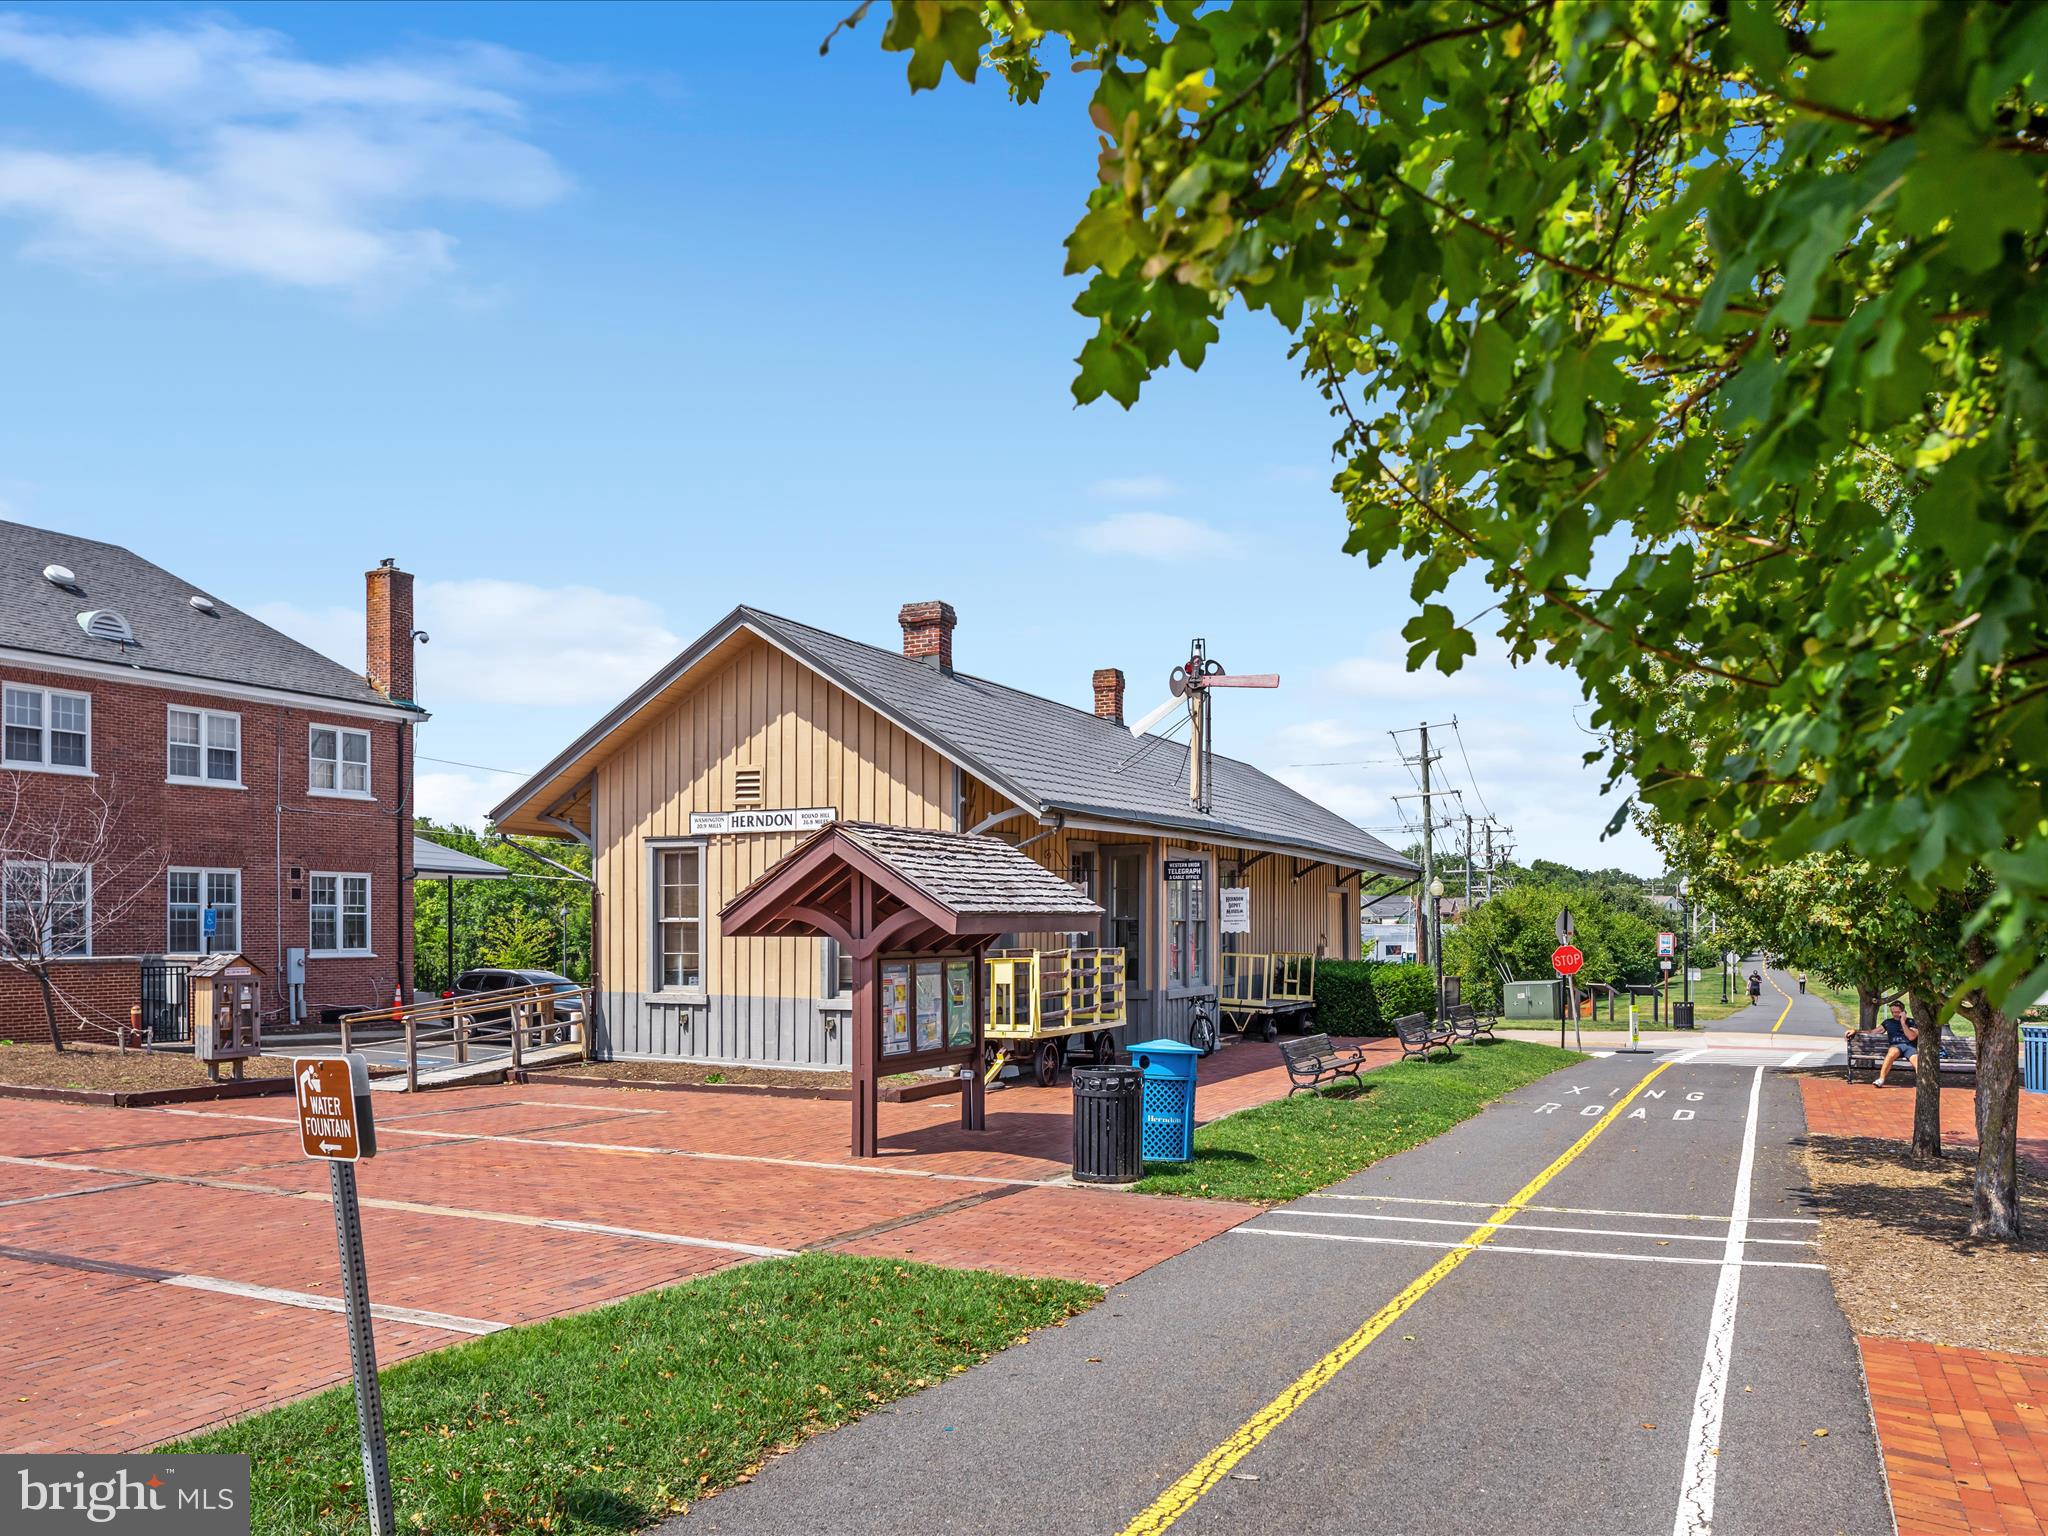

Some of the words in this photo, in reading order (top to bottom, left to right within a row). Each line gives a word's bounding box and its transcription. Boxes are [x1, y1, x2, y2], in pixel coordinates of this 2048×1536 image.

[731, 813, 793, 828] HERNDON
[1555, 953, 1581, 967] STOP
[1563, 1085, 1705, 1101] XING
[310, 1096, 342, 1116] WATER
[1533, 1102, 1696, 1121] ROAD
[1147, 1114, 1182, 1123] Herndon
[305, 1117, 352, 1138] FOUNTAIN
